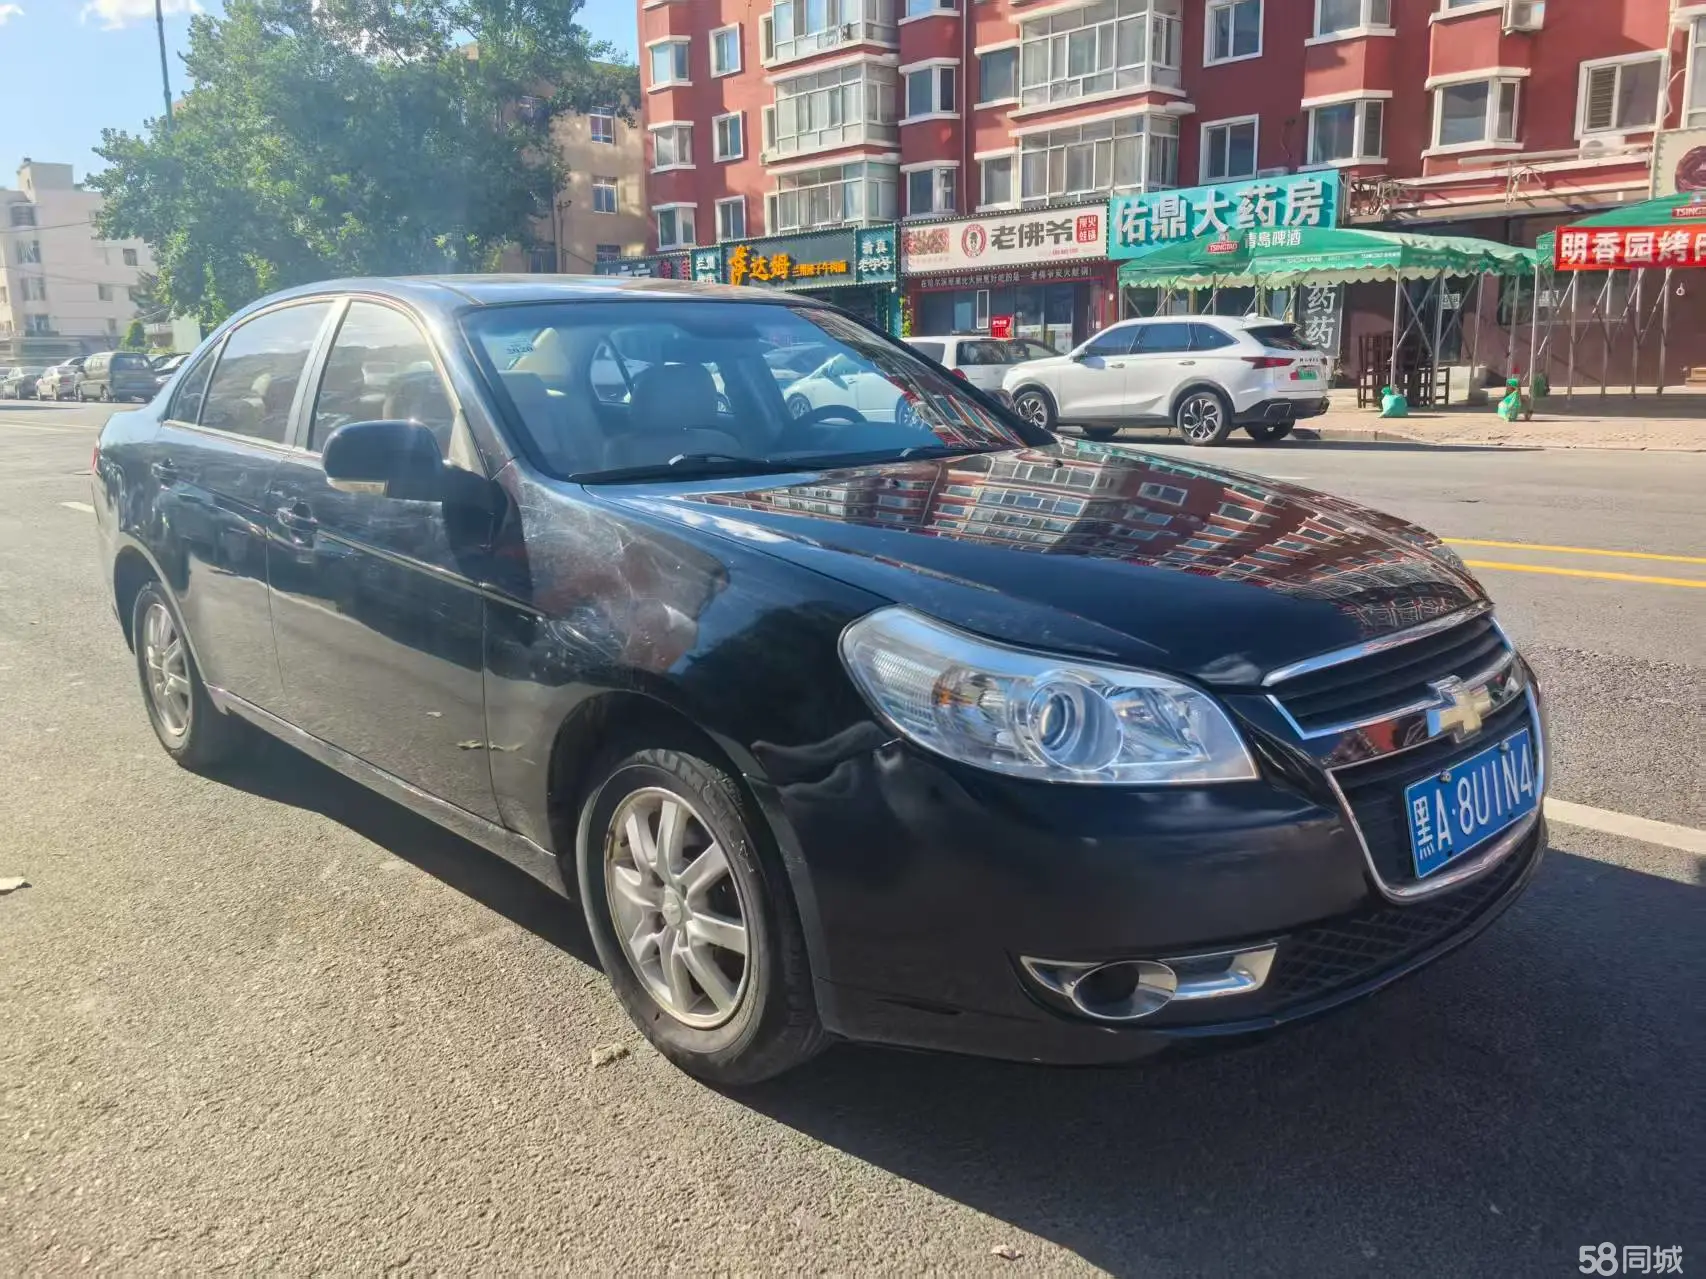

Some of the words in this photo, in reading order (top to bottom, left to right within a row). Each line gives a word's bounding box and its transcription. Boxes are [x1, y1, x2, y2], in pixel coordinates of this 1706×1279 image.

[1115, 177, 1324, 245] 佑鼎大药房
[991, 218, 1073, 250] 老佛爷
[1210, 243, 1238, 252] TSINGTAO
